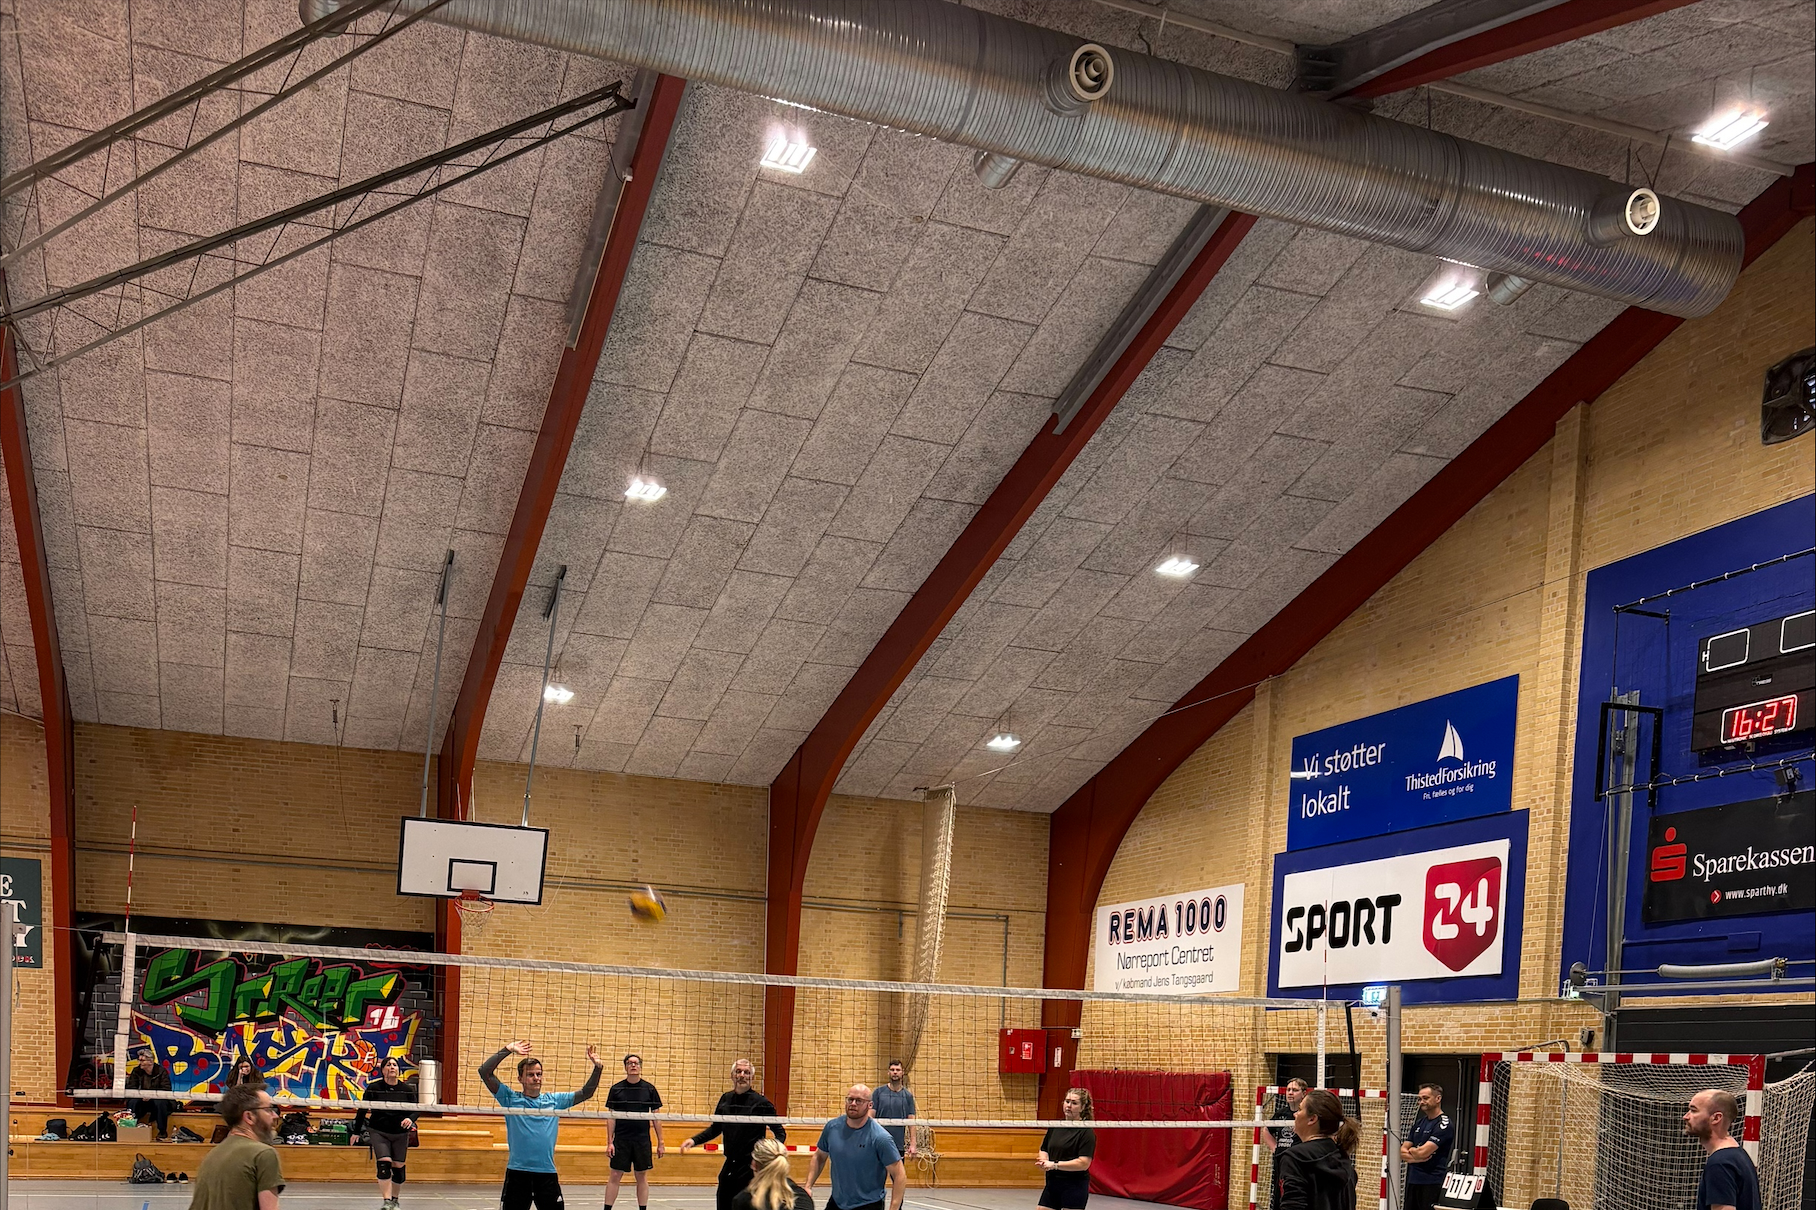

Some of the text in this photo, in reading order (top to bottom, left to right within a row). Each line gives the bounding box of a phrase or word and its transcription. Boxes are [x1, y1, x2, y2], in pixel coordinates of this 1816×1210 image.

[1731, 698, 1795, 738] 16:27
[1303, 742, 1386, 780] Vi støtter
[1405, 759, 1497, 791] ThistedForsikring
[1301, 784, 1351, 819] lokalt
[1692, 846, 1816, 882] Sparekassen
[1725, 883, 1789, 900] www.sparthy.dk
[1108, 894, 1227, 945] REMA 1000
[1285, 877, 1494, 953] SPORT 24
[1117, 944, 1214, 973] Nørreport Centret
[1153, 975, 1170, 987] Jens
[1171, 971, 1214, 989] Tangsgaard
